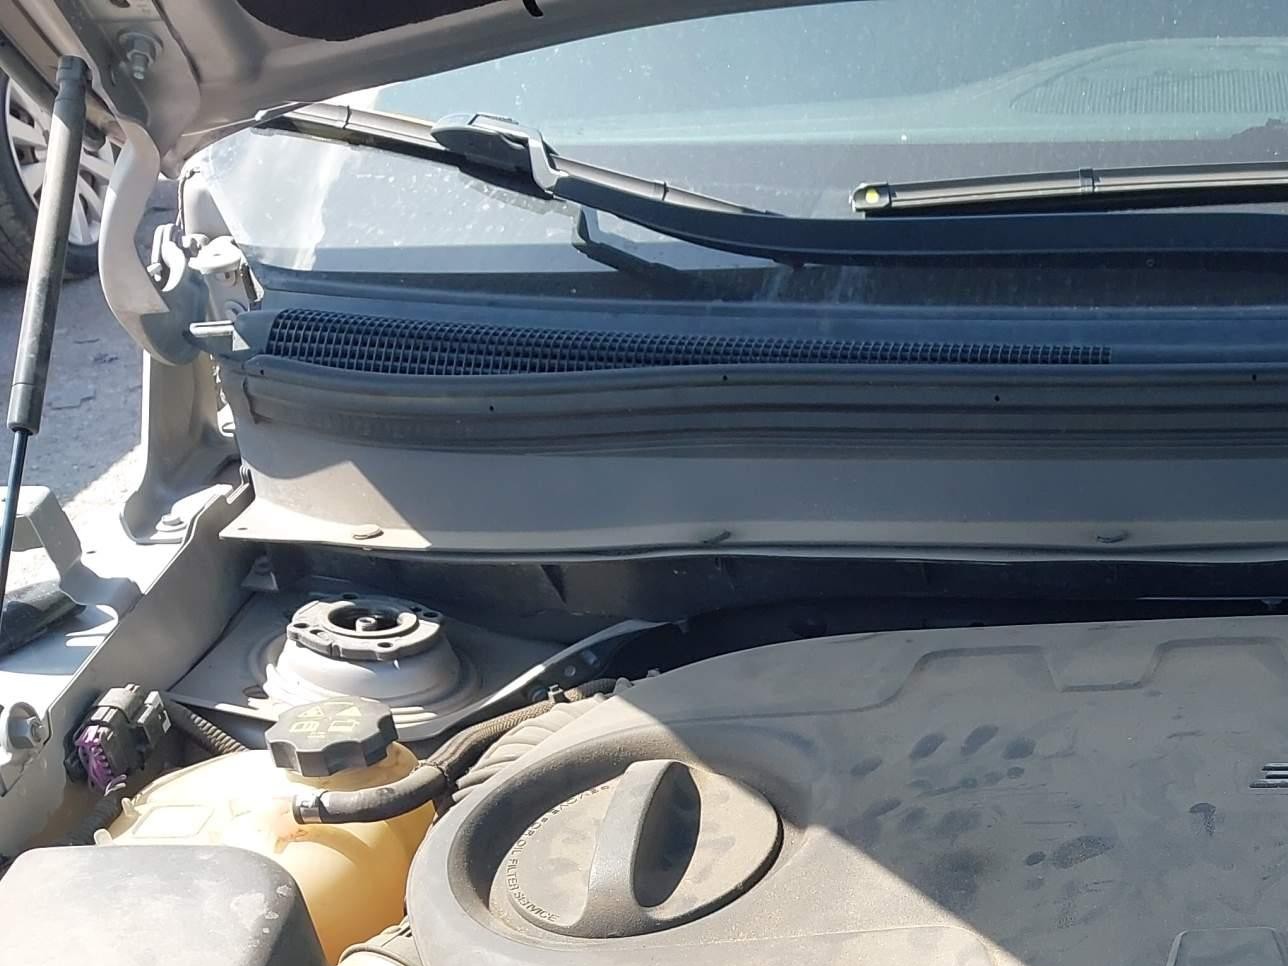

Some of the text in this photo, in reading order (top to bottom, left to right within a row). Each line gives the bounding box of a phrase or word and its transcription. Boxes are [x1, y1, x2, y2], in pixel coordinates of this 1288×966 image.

[511, 838, 528, 856] OIL
[504, 857, 521, 892] FILTER
[512, 891, 561, 922] SERVICE
